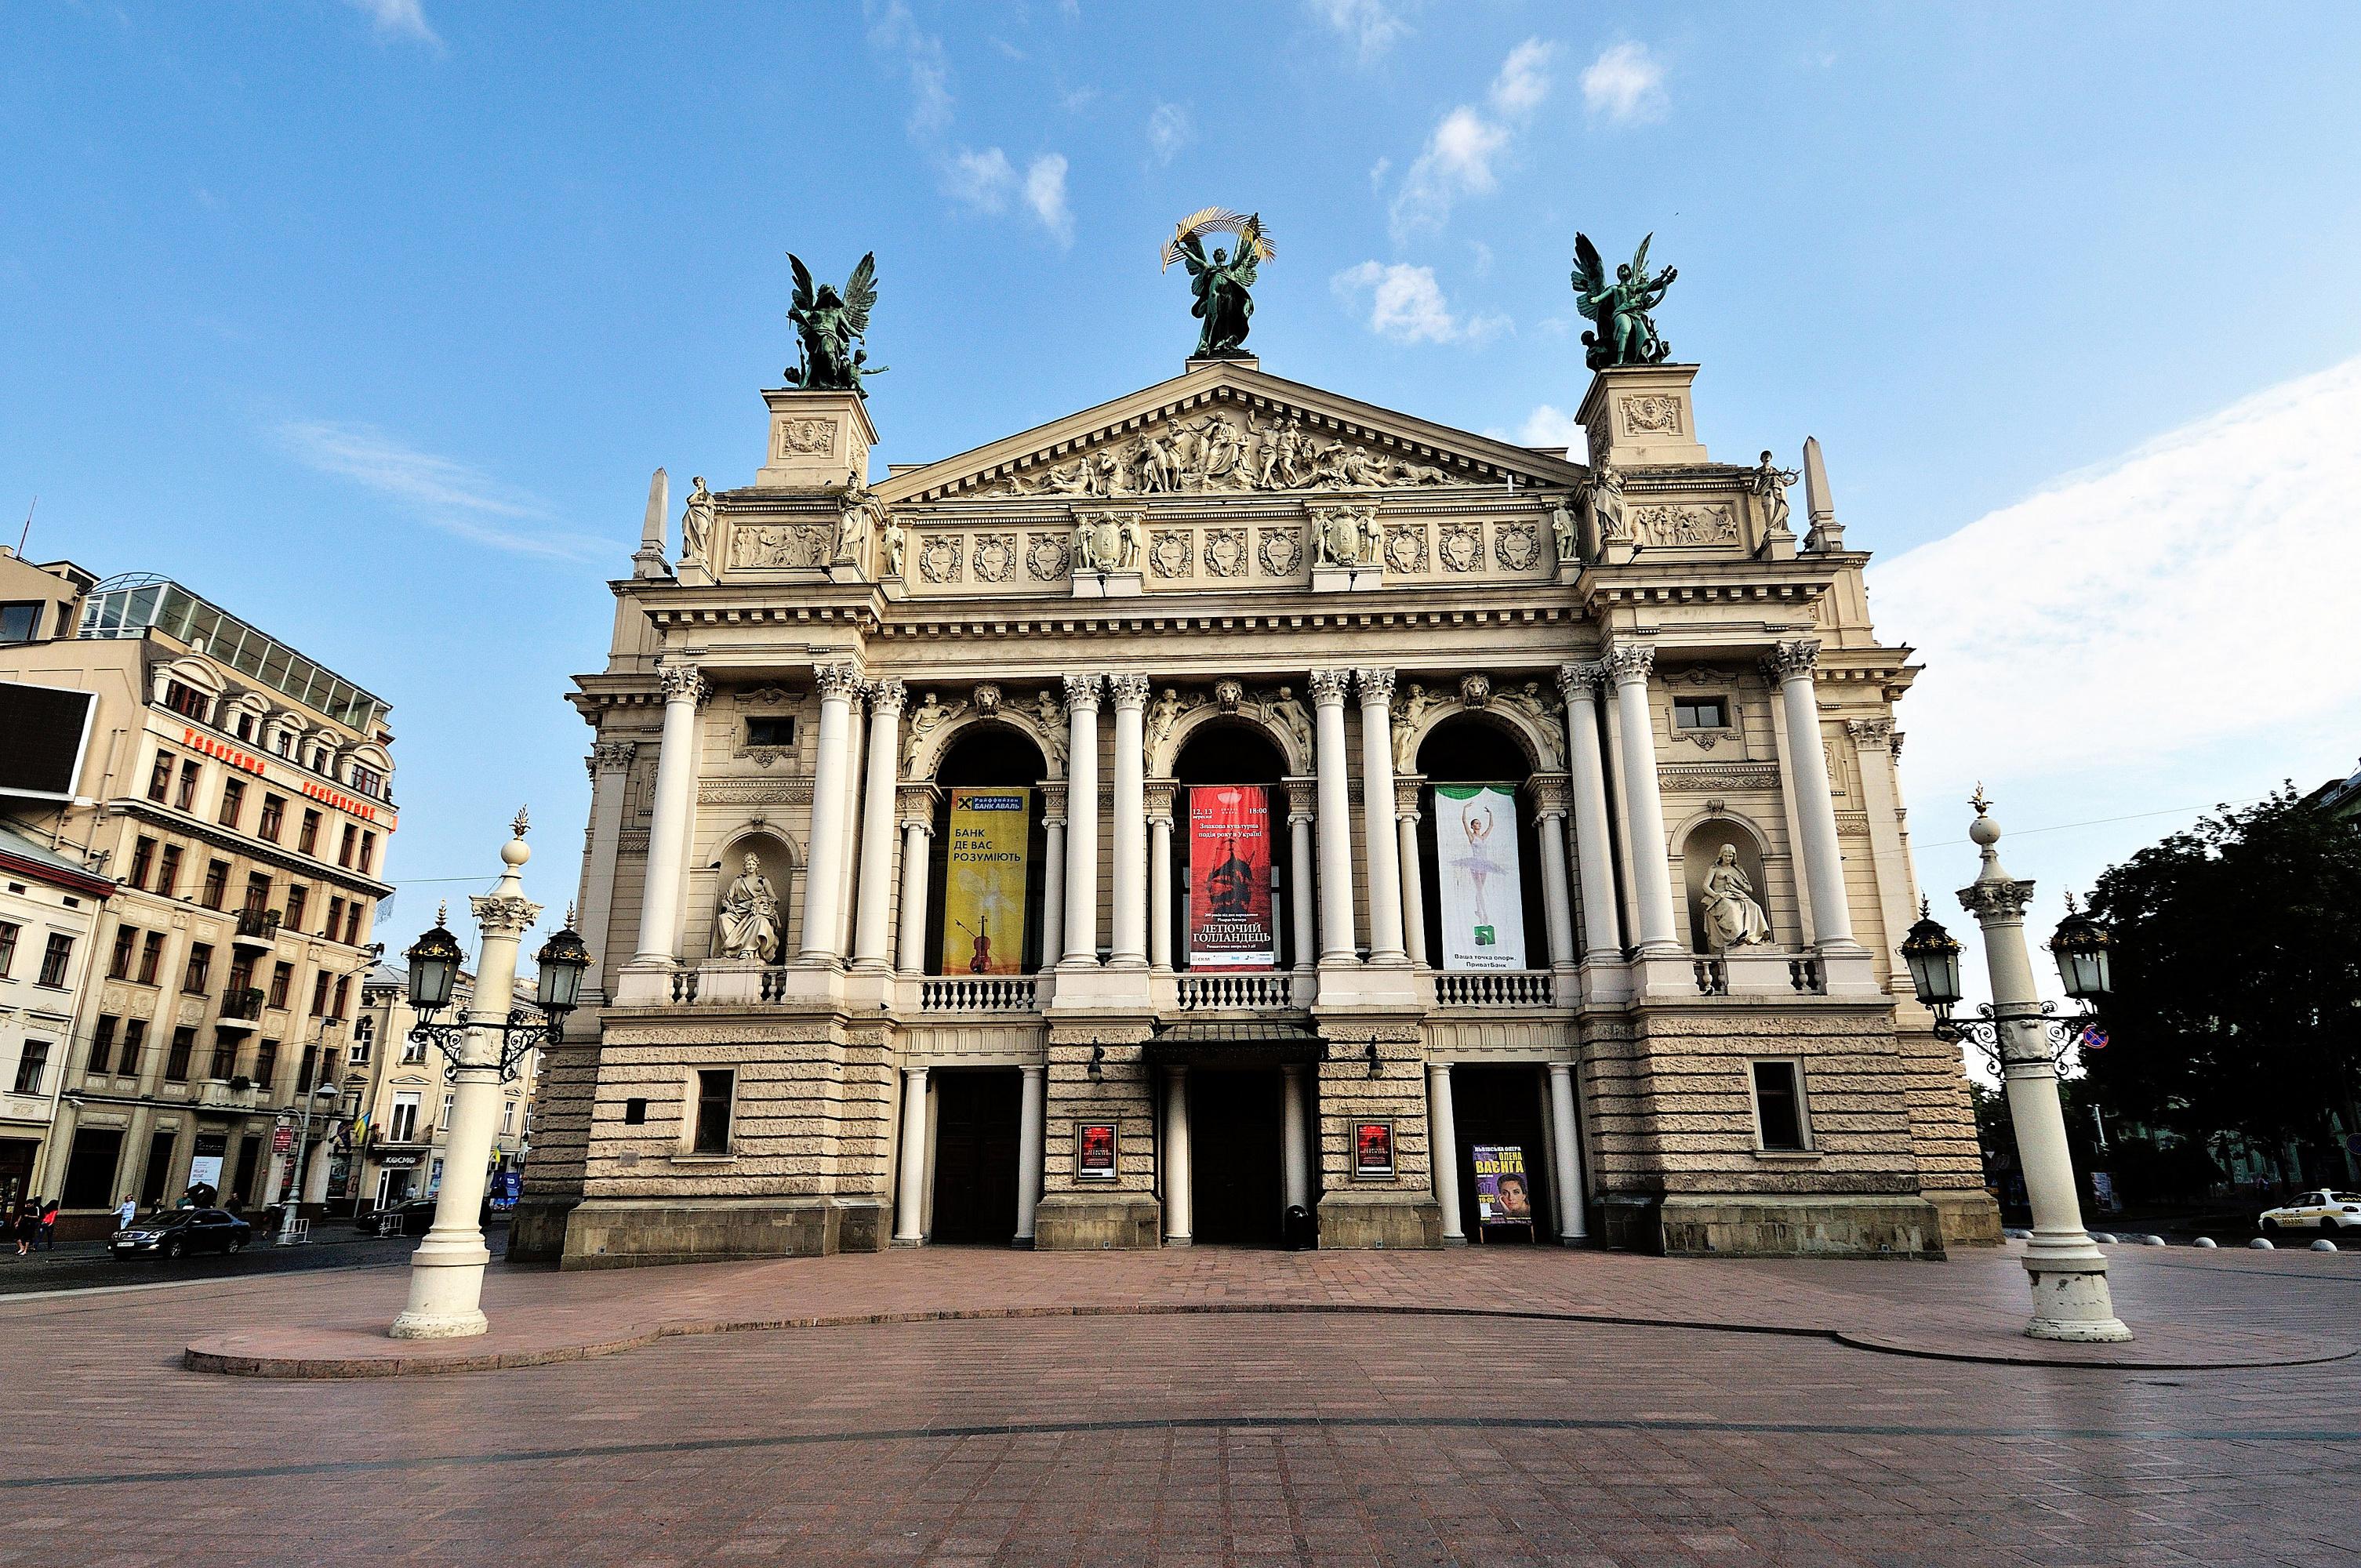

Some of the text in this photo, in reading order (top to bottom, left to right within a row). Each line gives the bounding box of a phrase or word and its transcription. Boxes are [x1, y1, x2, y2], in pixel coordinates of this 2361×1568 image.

[303, 782, 376, 820] restaurant
[955, 829, 985, 837] БАНК
[953, 841, 993, 851] ДЕ ВАС
[953, 852, 1021, 862] РОЗУМІЮТЬ
[1202, 922, 1262, 933] ЛЕТЮЧИЙ
[1193, 932, 1271, 943] ГОЛЛАНДЕЦЬ
[1498, 1152, 1523, 1160] ОЛЕНА
[1475, 1160, 1524, 1174] ВАЄНГА
